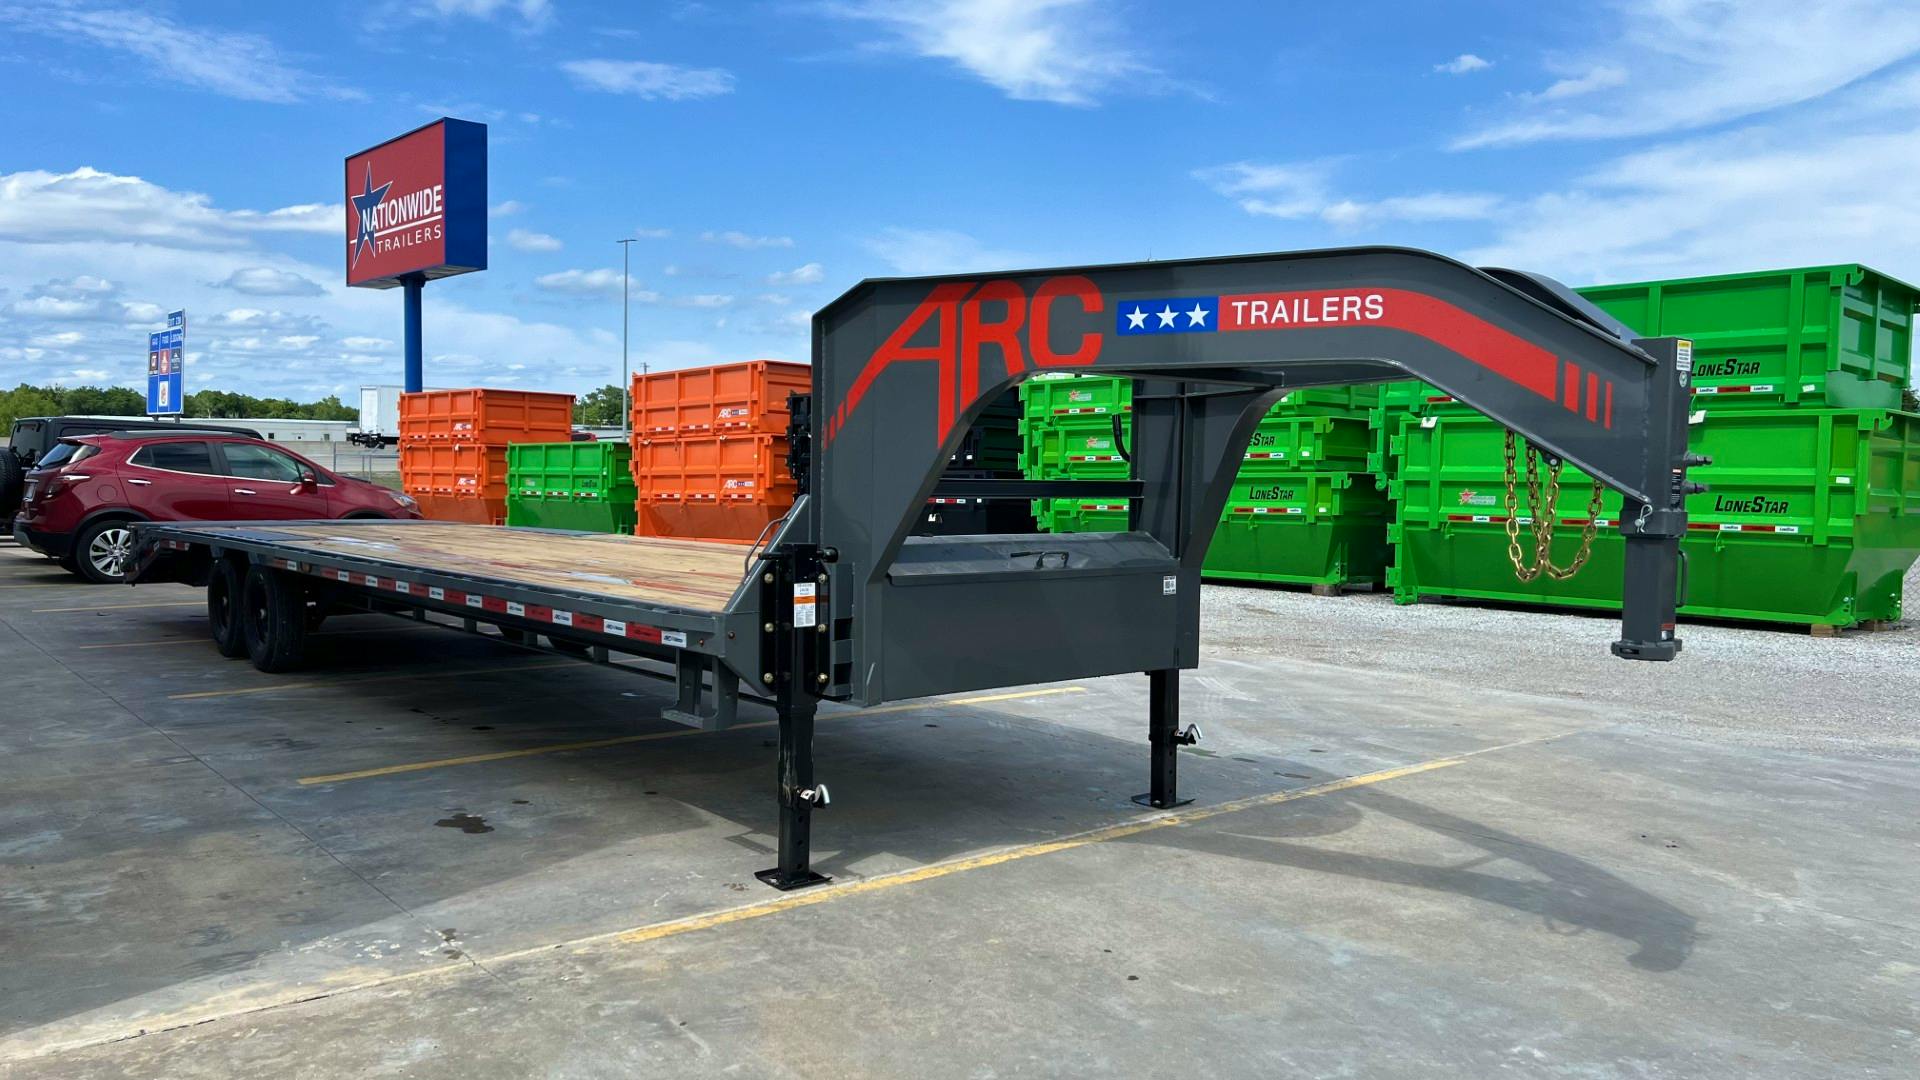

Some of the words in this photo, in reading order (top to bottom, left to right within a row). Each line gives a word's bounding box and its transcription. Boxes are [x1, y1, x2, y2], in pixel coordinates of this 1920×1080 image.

[362, 184, 443, 235] NATIONWIDE
[376, 224, 442, 253] TRAILERS
[1231, 294, 1384, 327] TRAILERS
[838, 275, 1105, 450] ARC
